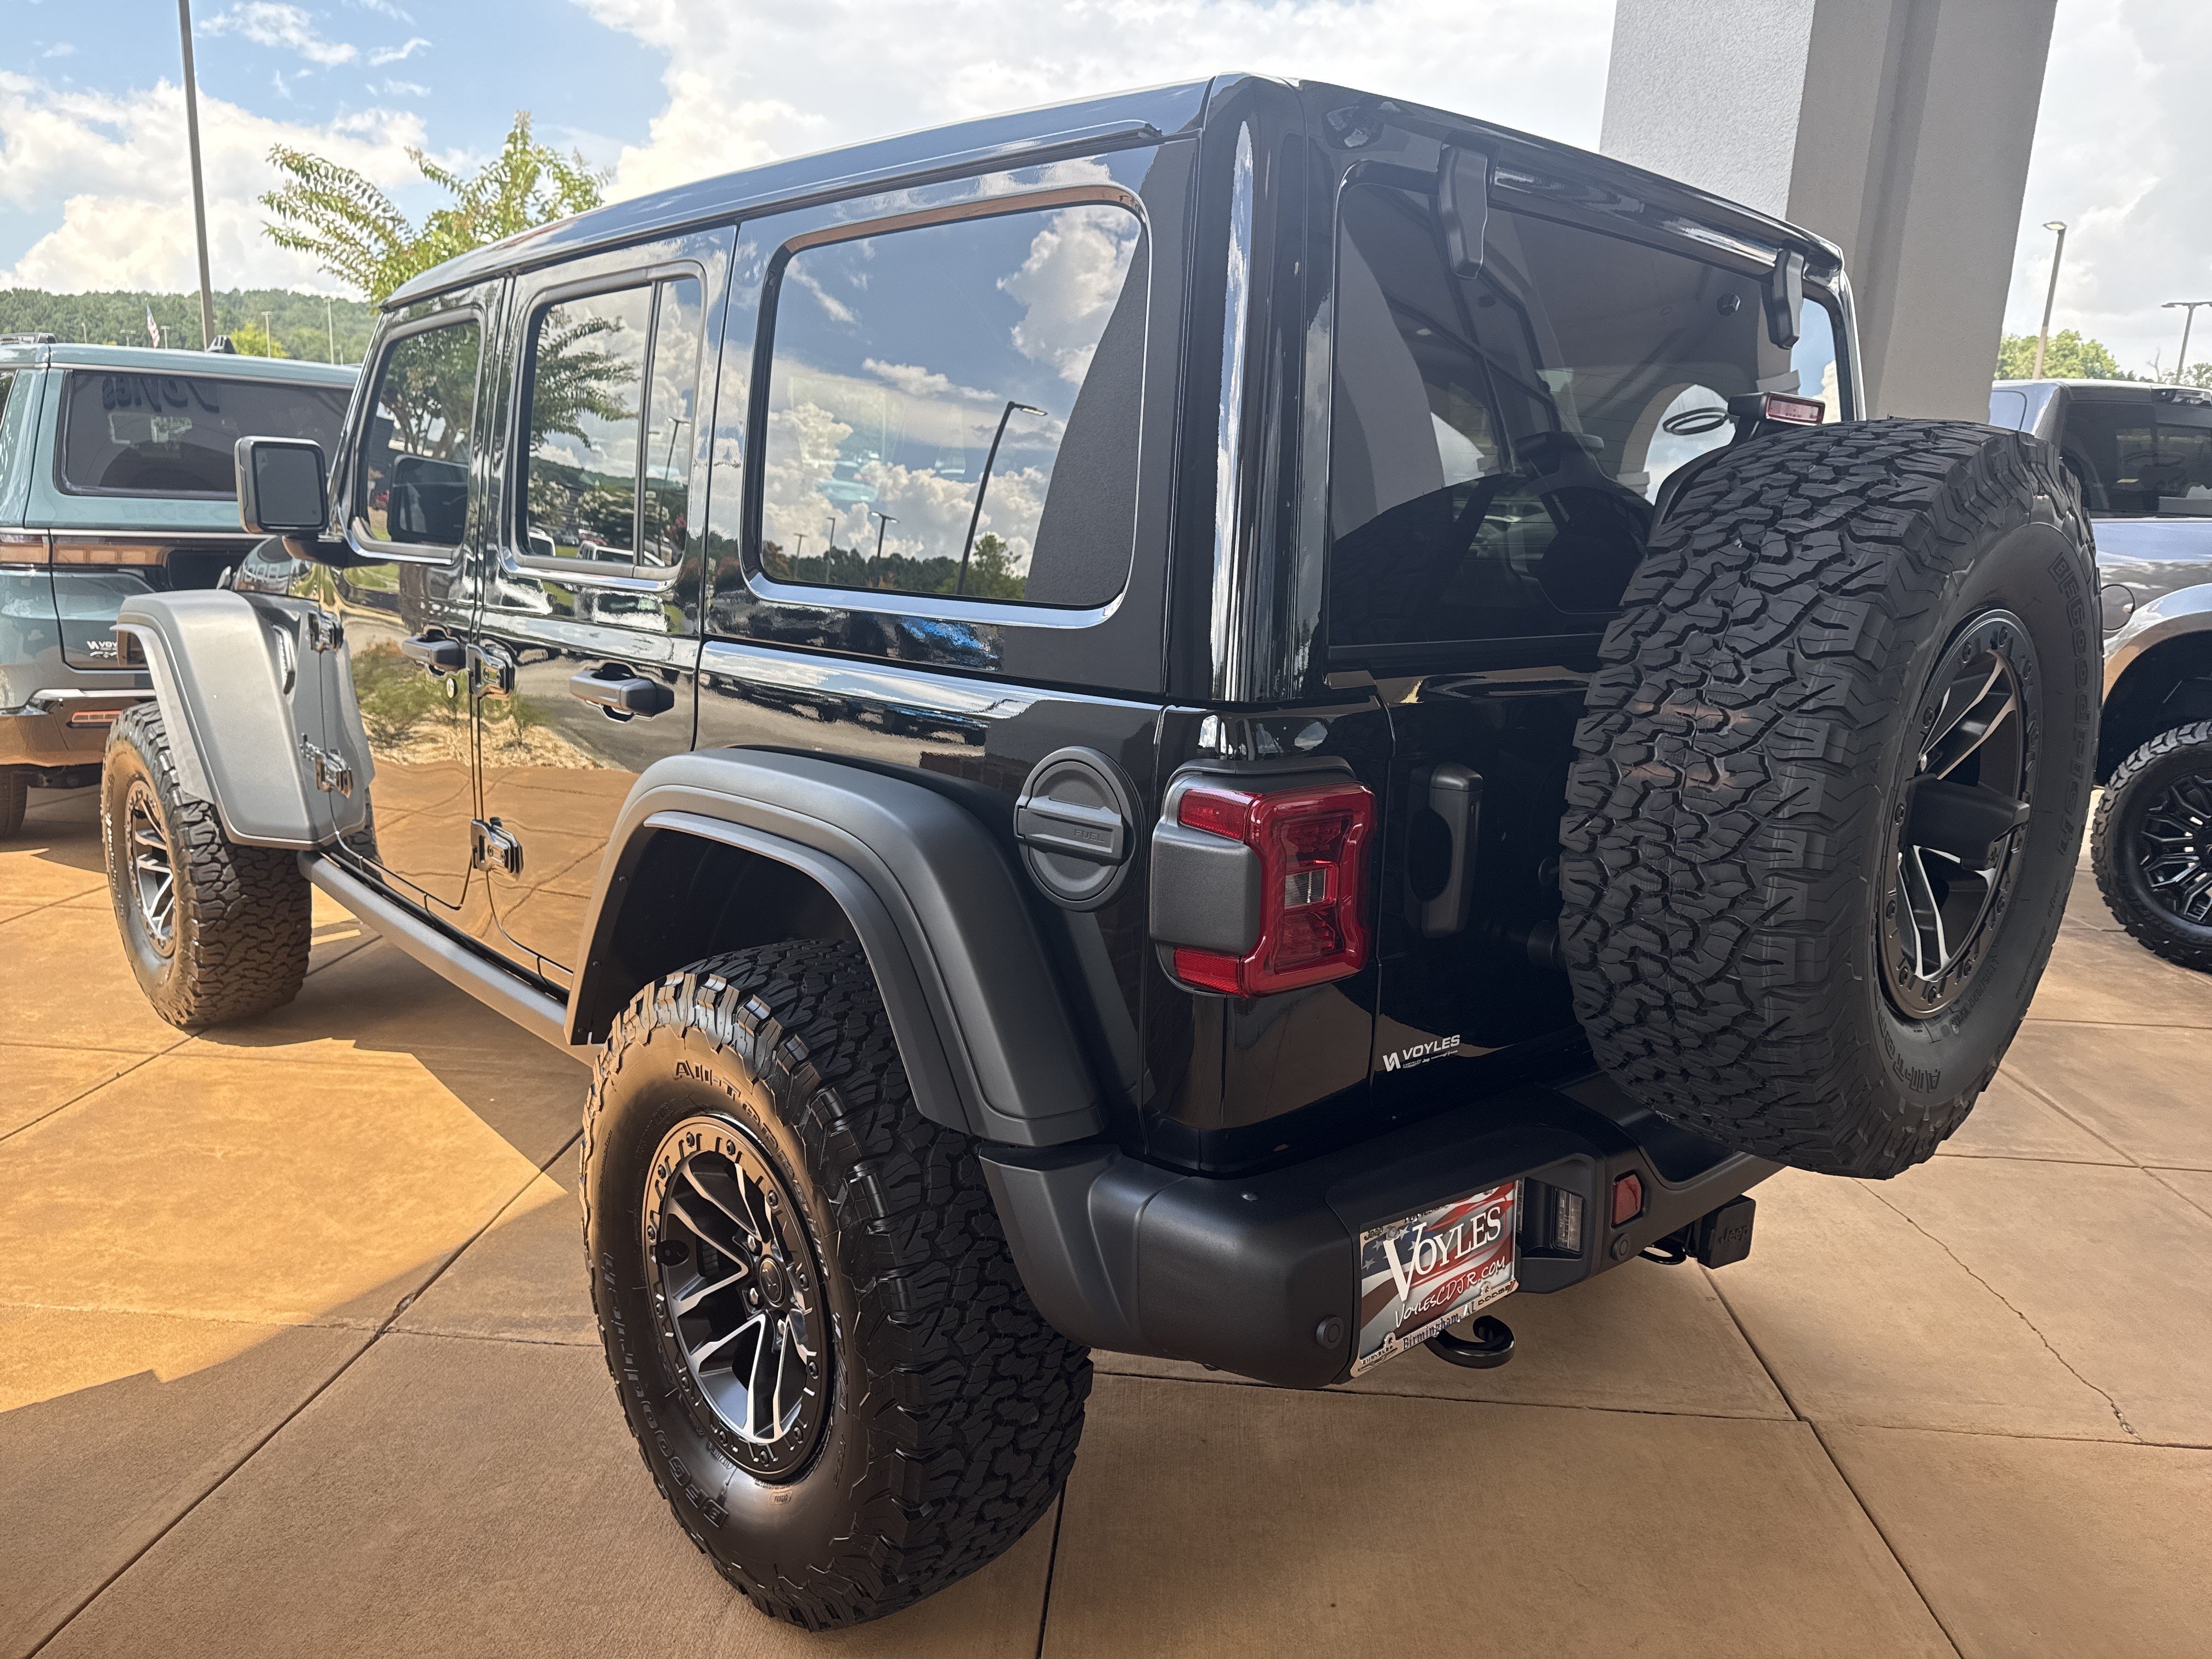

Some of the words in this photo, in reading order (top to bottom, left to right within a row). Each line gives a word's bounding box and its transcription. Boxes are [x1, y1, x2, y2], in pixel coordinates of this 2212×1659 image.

[2048, 551, 2090, 856] BFGoodrich
[1074, 828, 1105, 843] FUEL
[1402, 1034, 1460, 1060] VOYLES
[673, 1059, 831, 1281] All-Terrain
[1364, 1226, 1384, 1241] Jeep
[1718, 1225, 1748, 1244] Jeep
[1383, 1206, 1502, 1302] VOYLES
[1477, 1285, 1510, 1306] DODGE
[1463, 1301, 1476, 1317] AL
[602, 1252, 729, 1528] BFGoodrich
